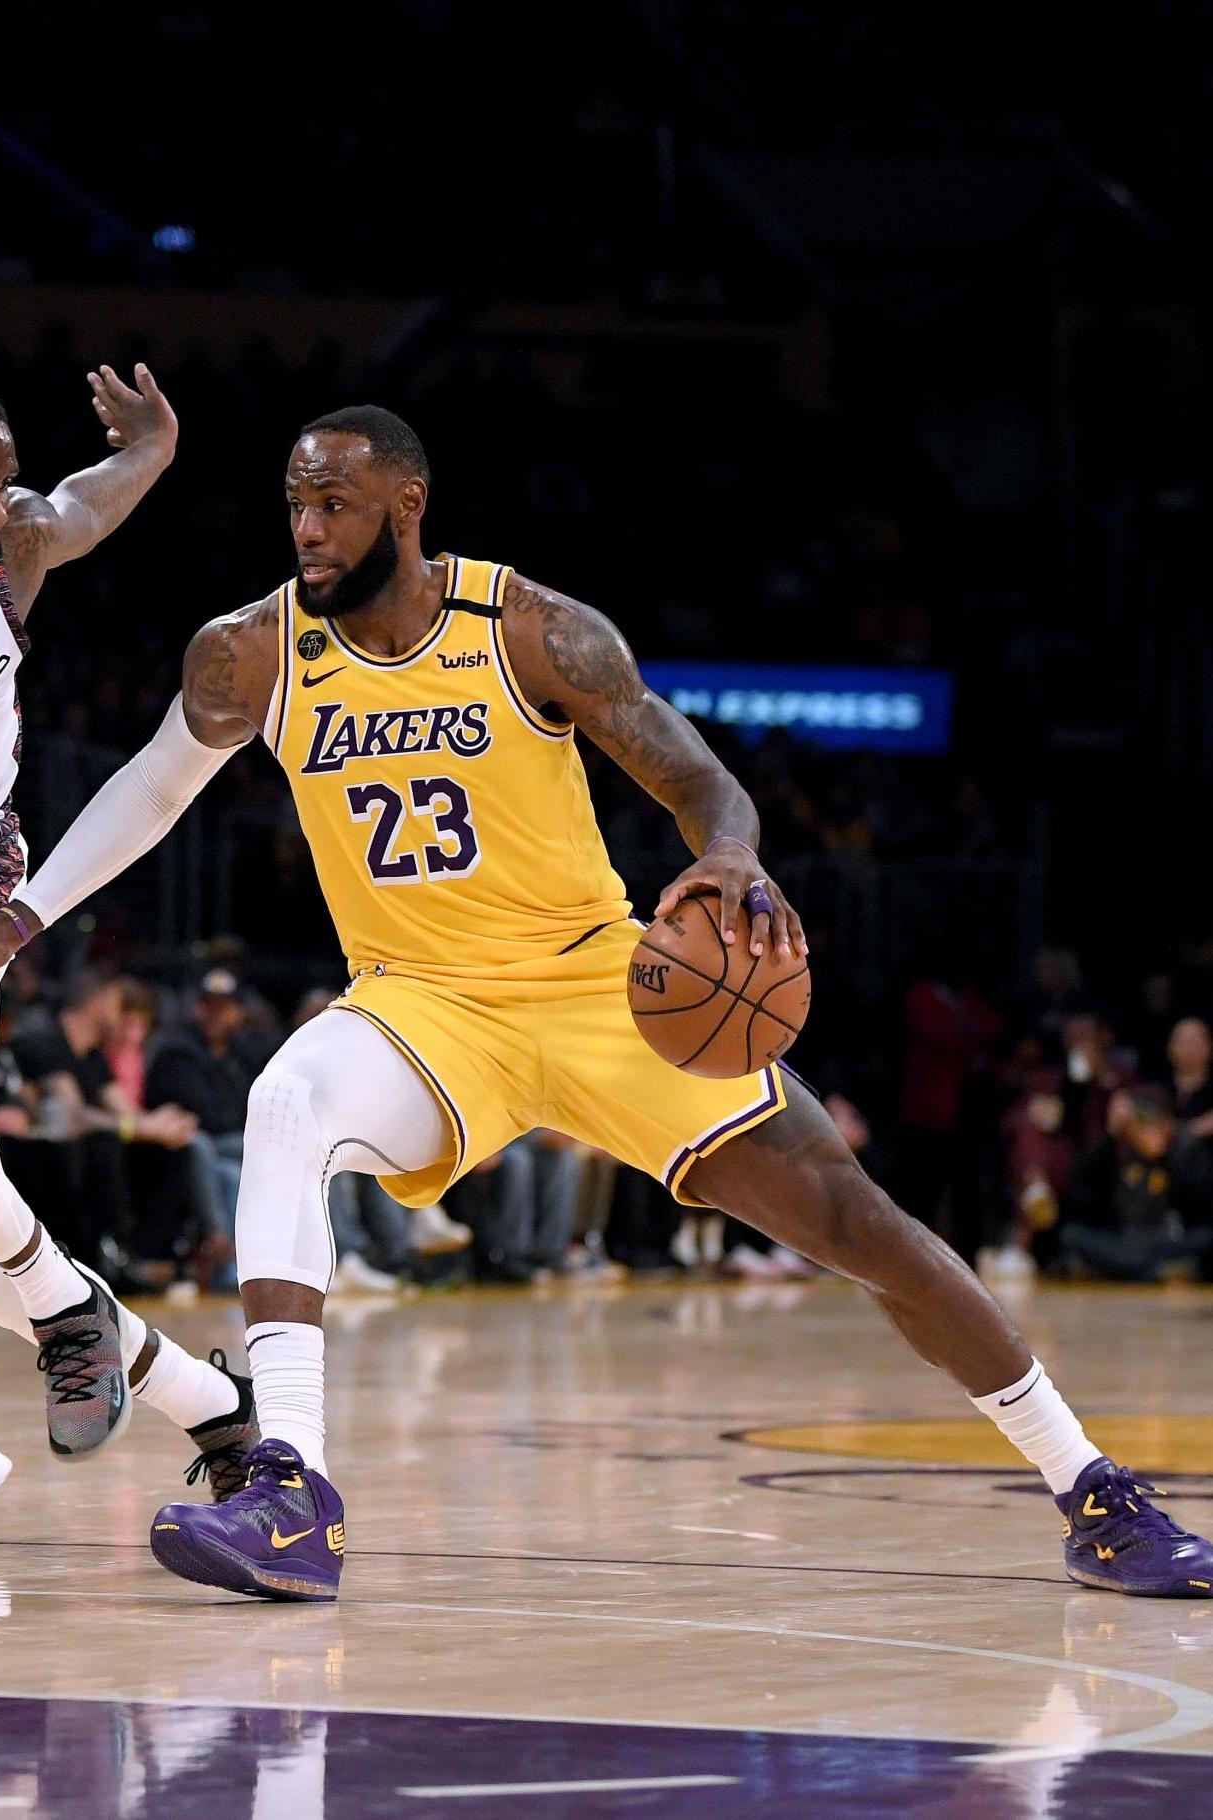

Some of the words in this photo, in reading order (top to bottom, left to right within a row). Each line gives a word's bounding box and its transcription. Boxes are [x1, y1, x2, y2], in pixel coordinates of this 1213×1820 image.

[437, 649, 489, 669] wish
[300, 701, 493, 775] LAKERS
[344, 775, 483, 887] 23
